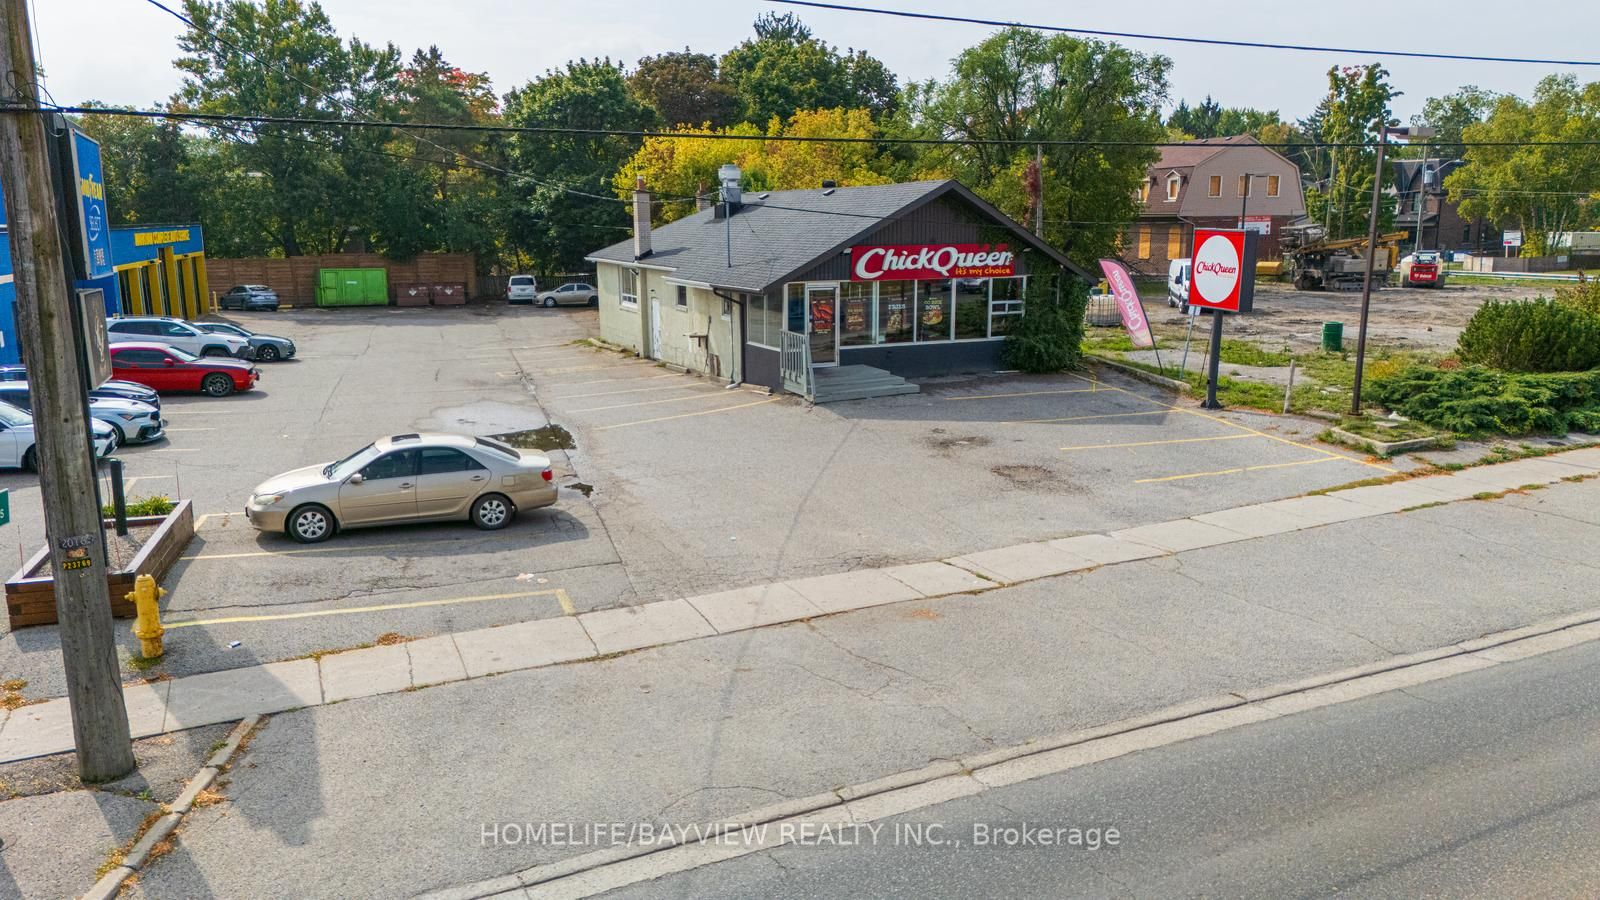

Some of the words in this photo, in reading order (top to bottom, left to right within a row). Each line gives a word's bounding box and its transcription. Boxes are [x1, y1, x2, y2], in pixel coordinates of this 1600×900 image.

[855, 246, 1014, 279] ChickQueen
[1196, 261, 1237, 276] ChickQueen
[984, 266, 1011, 275] choice
